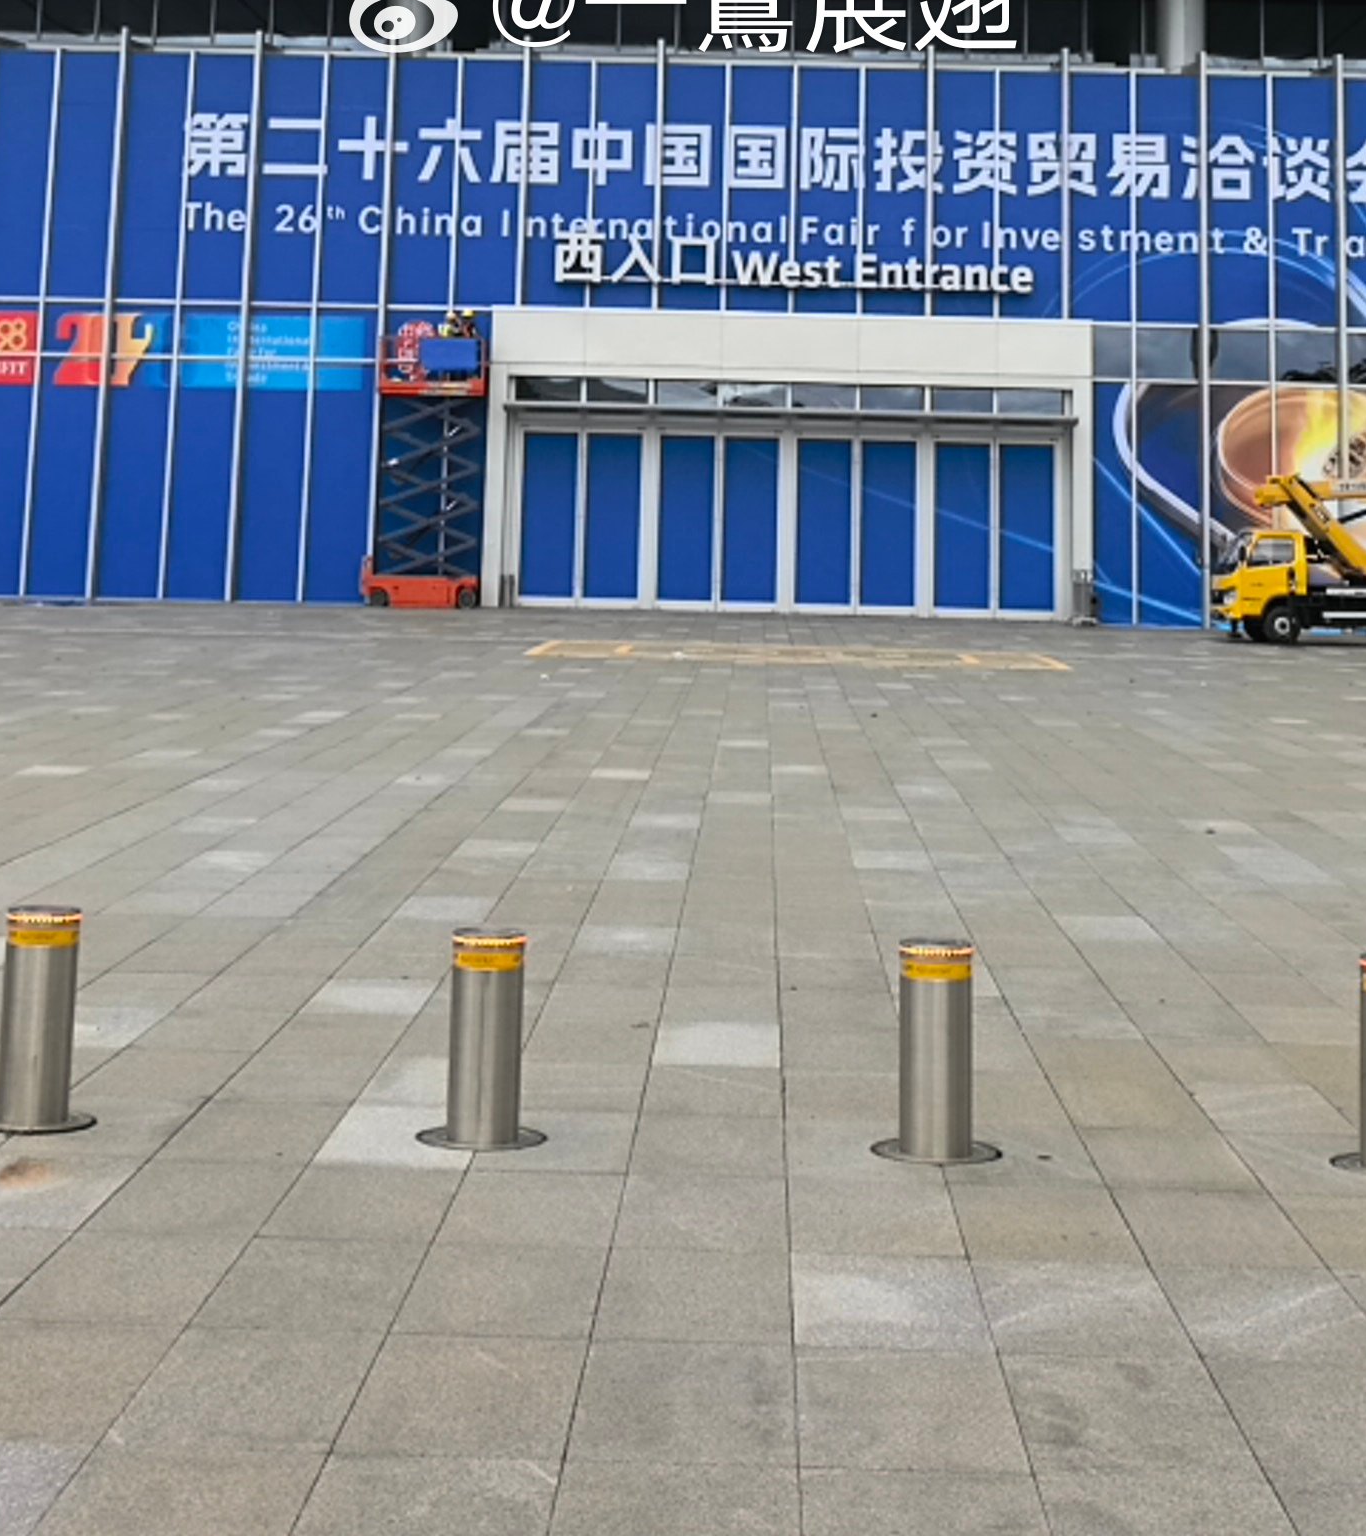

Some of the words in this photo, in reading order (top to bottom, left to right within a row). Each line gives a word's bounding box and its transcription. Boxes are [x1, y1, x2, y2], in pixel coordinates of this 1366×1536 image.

[185, 202, 247, 232] The
[358, 206, 482, 237] China
[501, 210, 787, 243] International
[801, 216, 880, 247] Fair
[982, 221, 1225, 255] Investment
[1243, 227, 1268, 256] &
[554, 230, 717, 284] 西入口
[731, 250, 841, 289] West
[857, 252, 1034, 293] Entrance
